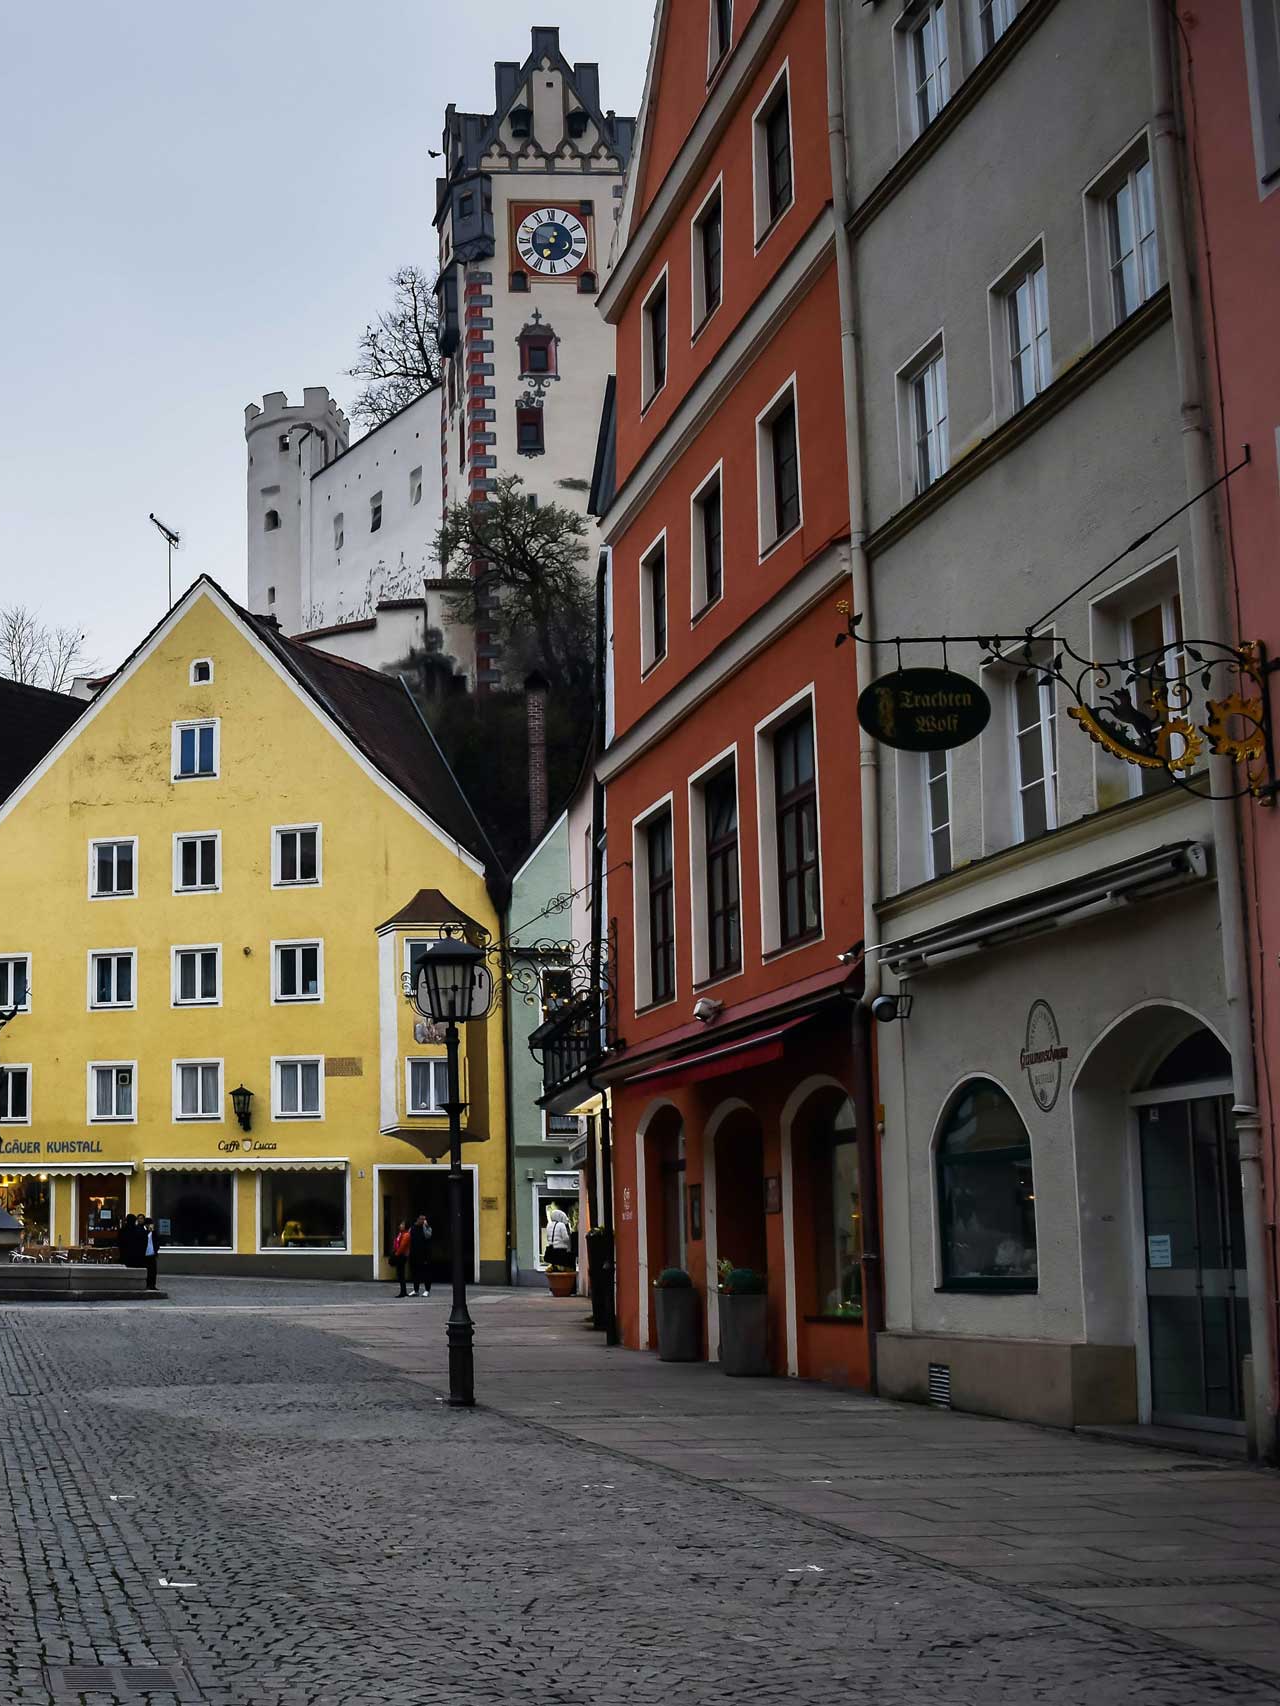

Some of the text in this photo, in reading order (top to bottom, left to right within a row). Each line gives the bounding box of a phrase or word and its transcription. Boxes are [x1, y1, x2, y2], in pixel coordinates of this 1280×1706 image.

[899, 689, 973, 708] Trachten
[914, 714, 959, 733] Wolf
[46, 1140, 103, 1153] KUHSTALL
[253, 1140, 277, 1151] Lucca
